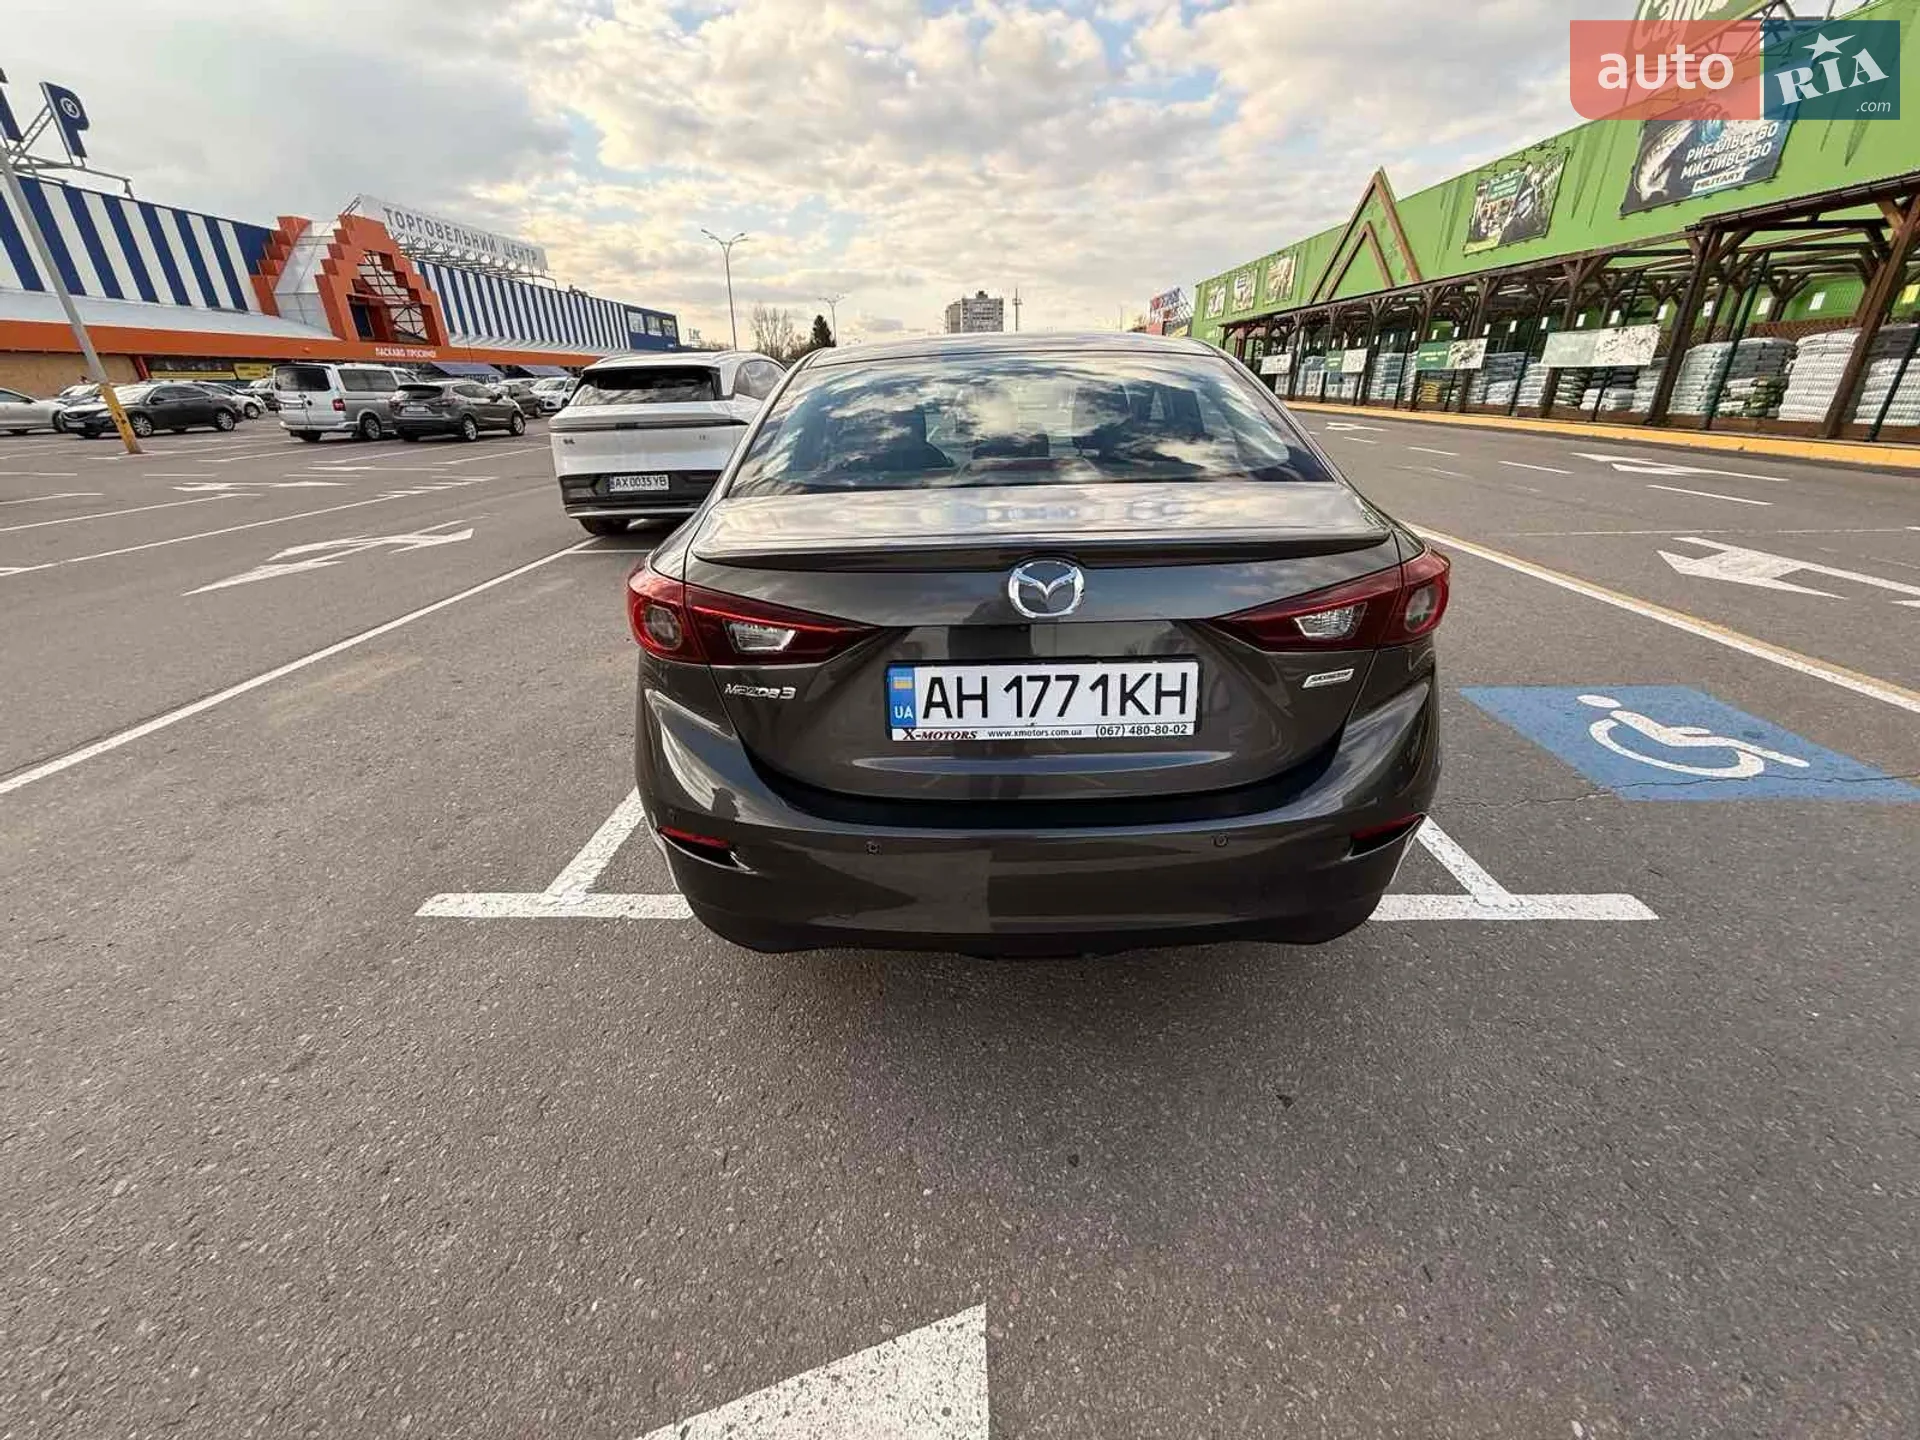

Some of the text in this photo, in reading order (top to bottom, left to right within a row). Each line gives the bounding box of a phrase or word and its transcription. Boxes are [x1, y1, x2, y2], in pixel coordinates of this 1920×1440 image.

[1680, 141, 1772, 180] МИСЛИВСТВО
[1685, 121, 1779, 162] РИБАЛЬСТВО
[383, 207, 538, 262] ТОРГОВЕЛЬНИЙ ЦЕНТР
[894, 705, 913, 719] UA
[923, 676, 989, 719] AH
[902, 724, 1188, 741] X-MOTORS www.xmotors.com.ua (067) 480-80-02
